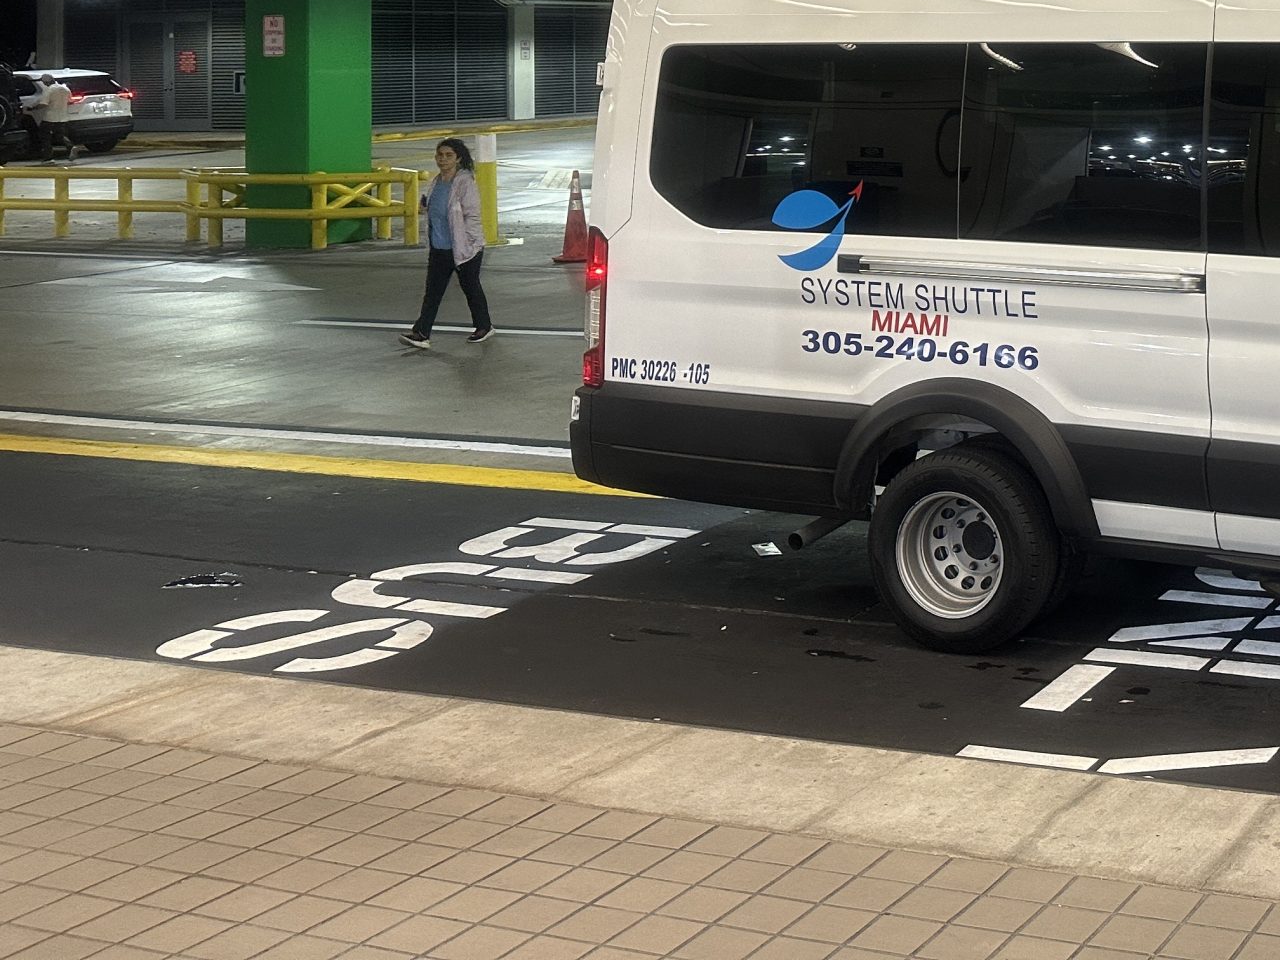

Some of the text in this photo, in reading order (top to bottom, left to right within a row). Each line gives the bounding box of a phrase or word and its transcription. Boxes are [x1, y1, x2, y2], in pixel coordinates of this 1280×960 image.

[801, 277, 1039, 319] SYSTEM SHUTTLE
[871, 309, 949, 337] MIAMI
[611, 357, 710, 385] PMC 30226 -105
[801, 329, 1040, 371] 305-240-6166
[155, 516, 702, 673] BUS
